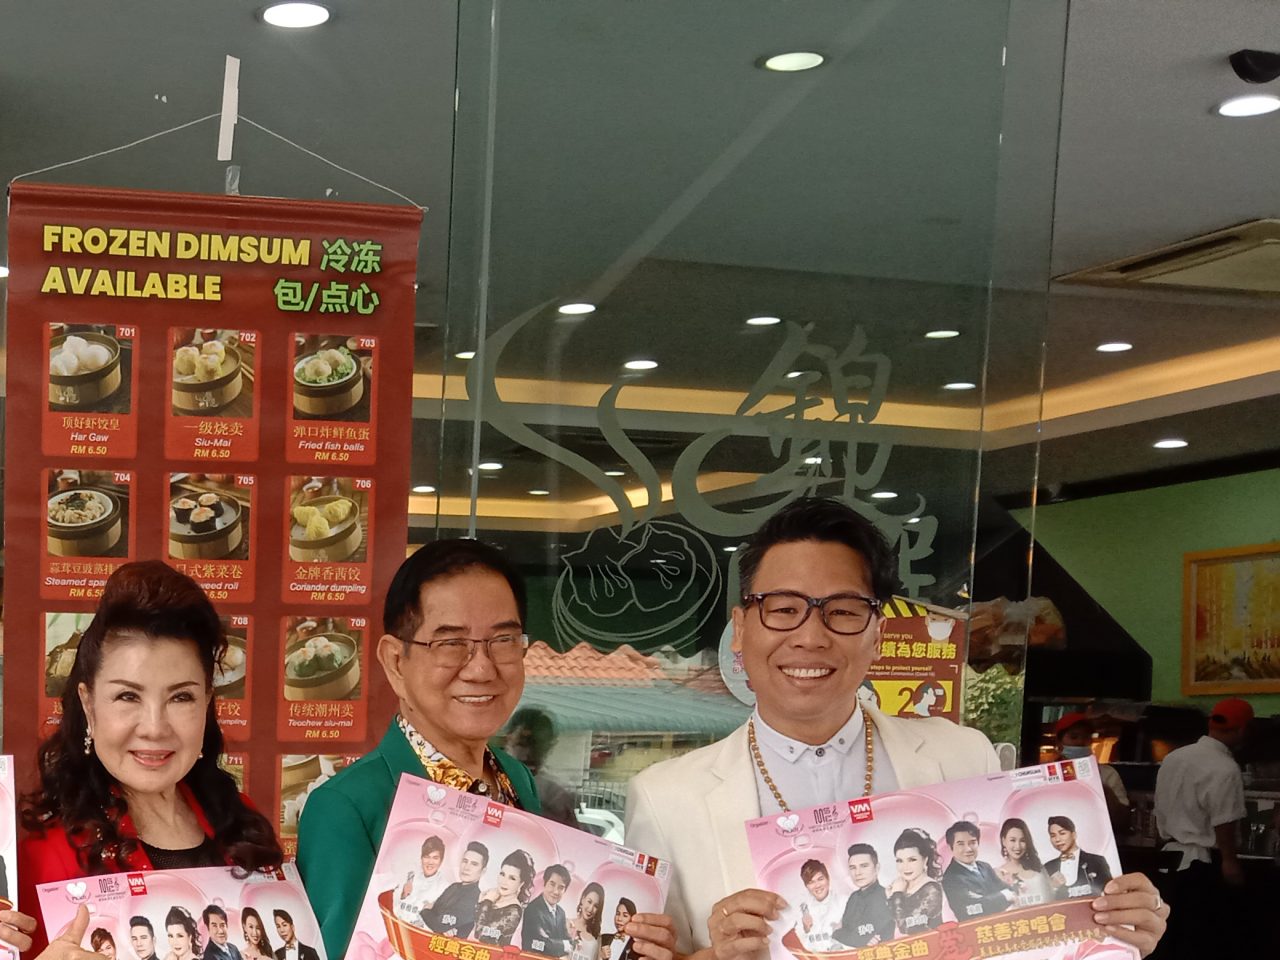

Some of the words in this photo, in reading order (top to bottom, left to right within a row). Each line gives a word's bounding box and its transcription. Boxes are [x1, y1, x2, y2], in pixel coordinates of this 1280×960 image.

[43, 225, 169, 258] FROZEN
[176, 233, 311, 266] DIMSUM
[320, 238, 382, 274] 冷冻
[41, 266, 222, 301] AVAILABLE
[274, 278, 380, 315] 包/点心
[119, 327, 136, 337] 701
[239, 331, 257, 342] 702
[360, 338, 376, 348] 703
[62, 416, 121, 431] 顶好虾饺皇
[70, 433, 87, 442] Har
[89, 433, 109, 442] Gaw
[293, 425, 370, 440] 弹口炸鲜鱼蛋
[195, 438, 231, 447] Siu-Mai
[298, 441, 323, 450] Fried
[324, 441, 341, 451] fish
[343, 442, 365, 451] balls
[70, 446, 86, 454] RM
[88, 446, 107, 455] 6.50
[194, 449, 210, 458] RM
[211, 449, 230, 458] 6.50
[314, 451, 329, 460] RM
[331, 452, 349, 461] 6.50
[114, 473, 131, 483] 704
[237, 475, 254, 485] 705
[355, 479, 372, 489] 706
[50, 562, 117, 576] 蒜茸豆豉蒸排
[44, 577, 87, 587] Steamed
[88, 579, 108, 588] spa
[200, 582, 223, 590] weed
[225, 582, 239, 590] roll
[69, 588, 84, 597] RM
[86, 589, 105, 598] 6.50
[289, 582, 329, 592] Coriander
[330, 583, 367, 594] dumpling
[209, 591, 228, 600] 6.50
[310, 592, 325, 601] RM
[327, 592, 345, 601] 6.50
[232, 616, 249, 626] 708
[350, 618, 366, 627] 709
[880, 641, 957, 659] 續為您服務
[288, 719, 322, 727] Teochew
[305, 730, 320, 738] RM
[321, 730, 340, 738] 6.50
[228, 757, 243, 765] 711
[346, 756, 361, 765] 71
[975, 913, 1067, 944] 慈善演唱會
